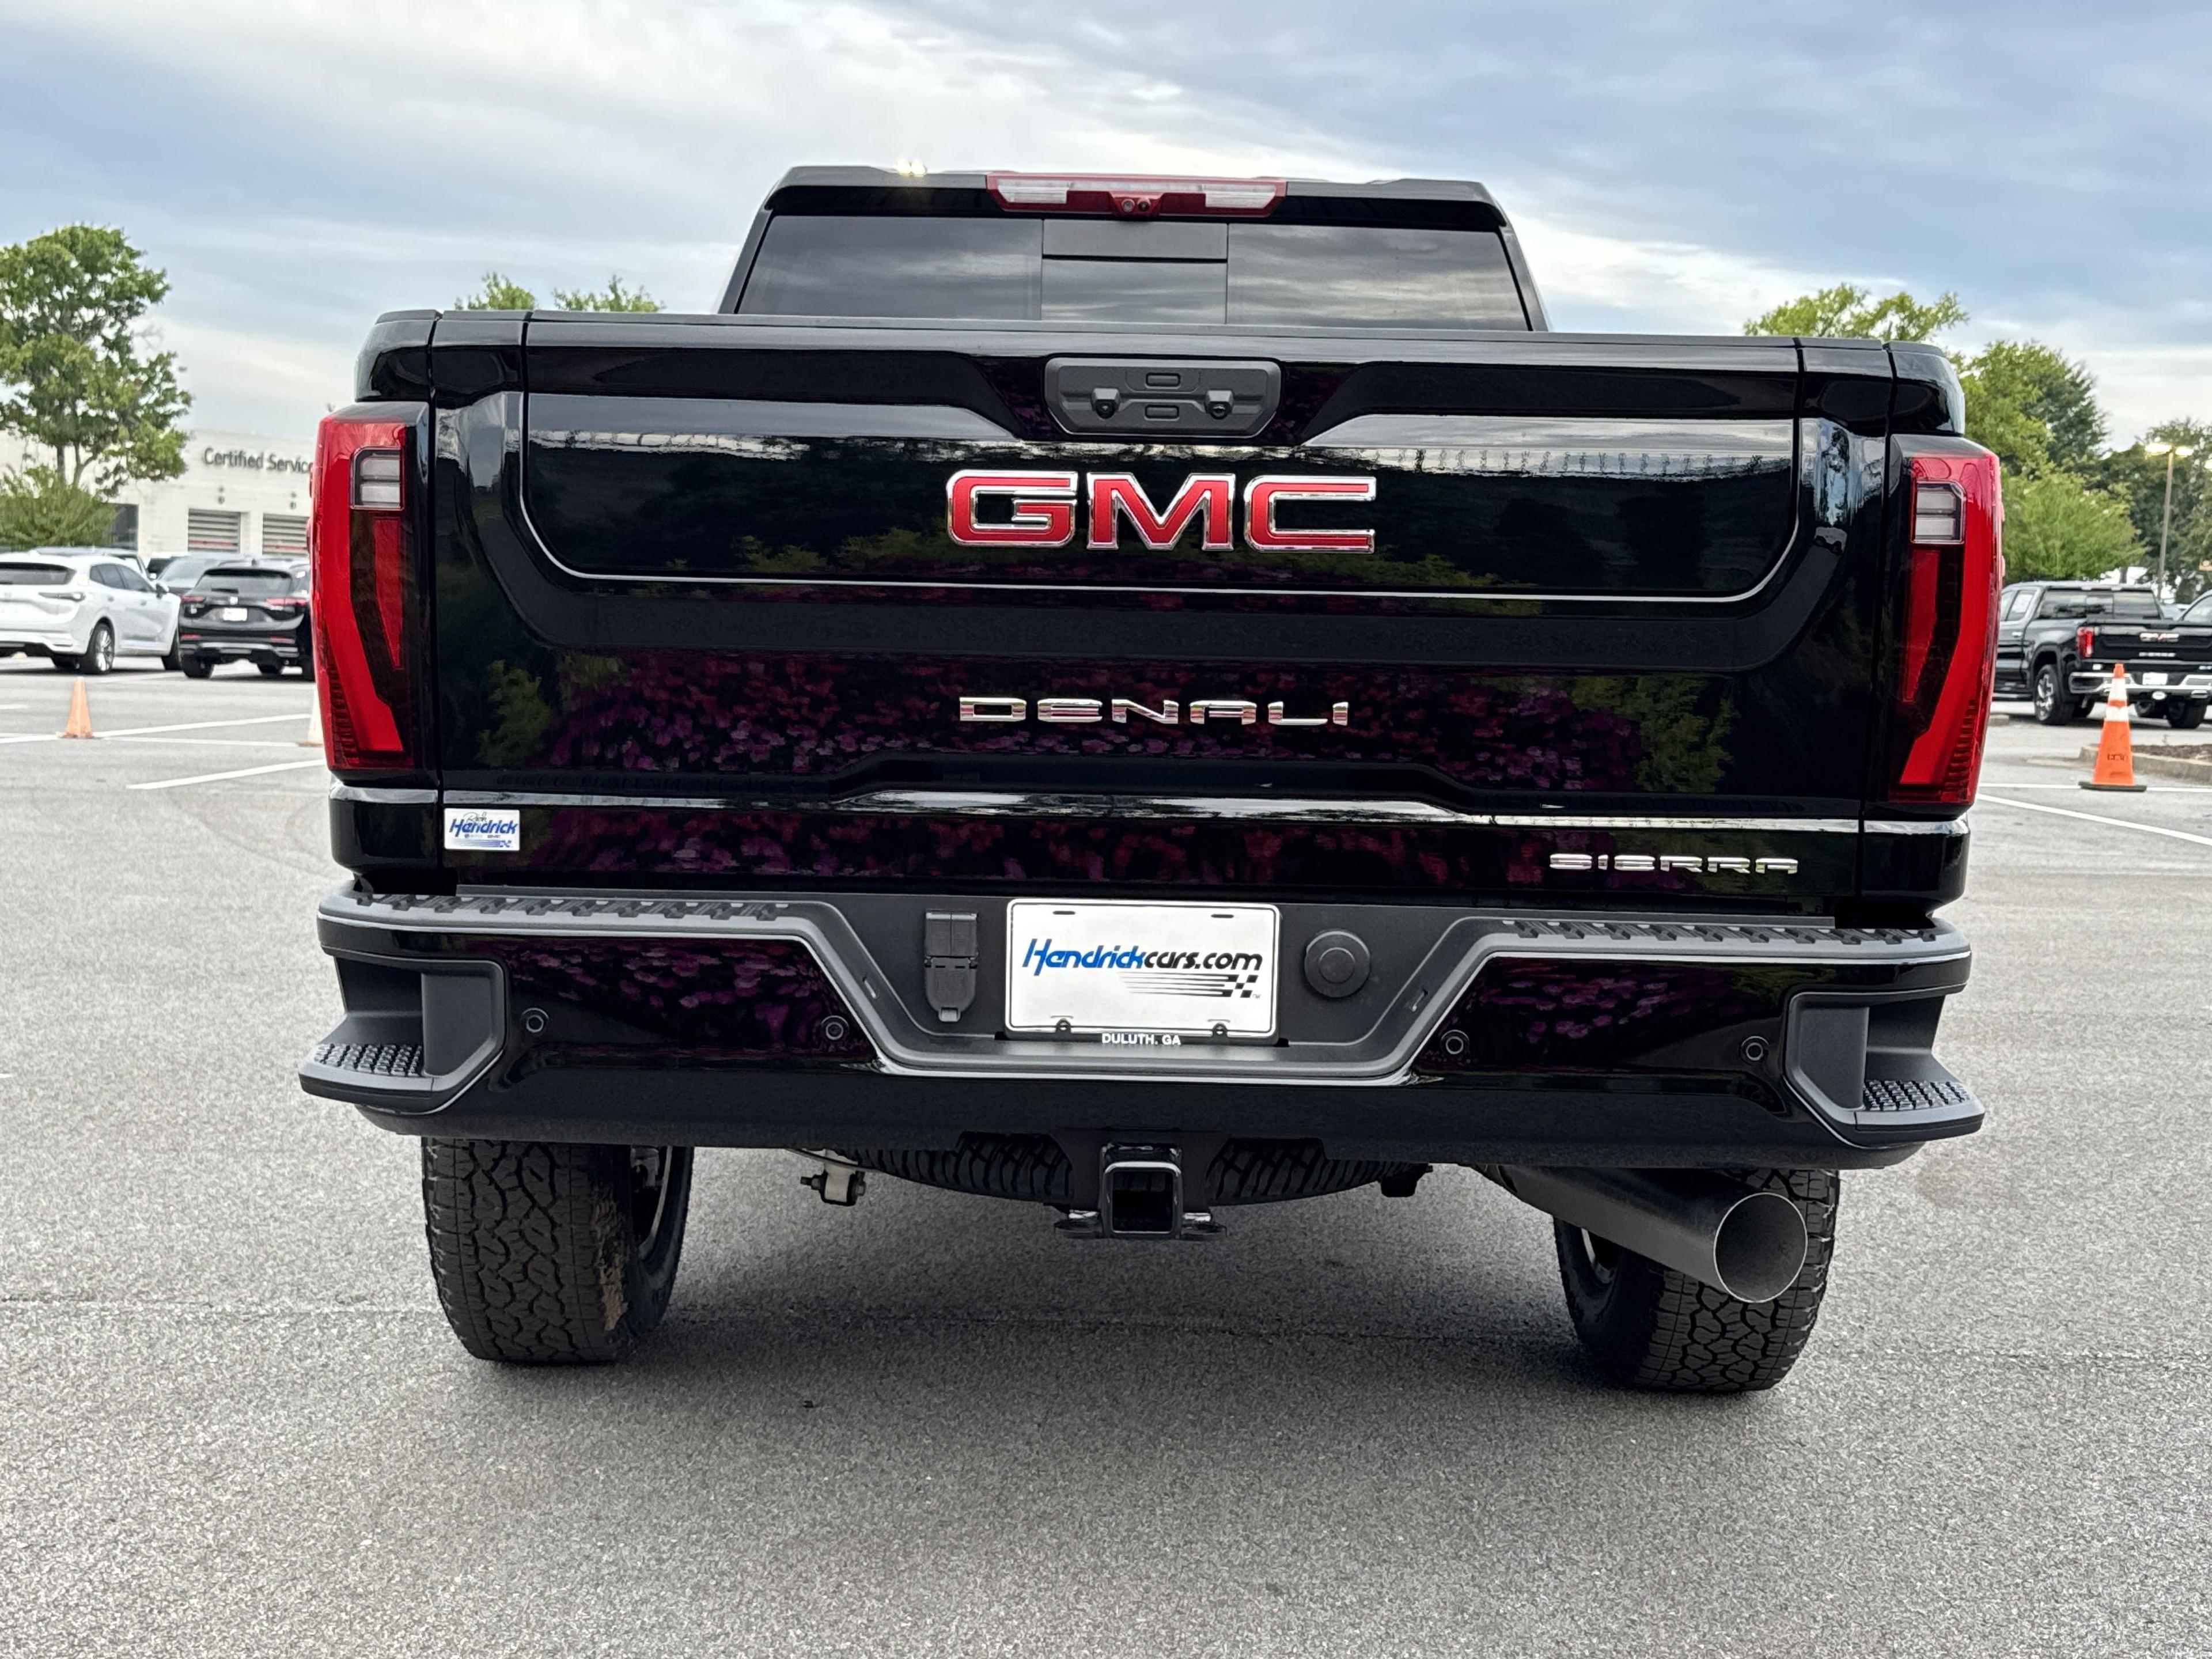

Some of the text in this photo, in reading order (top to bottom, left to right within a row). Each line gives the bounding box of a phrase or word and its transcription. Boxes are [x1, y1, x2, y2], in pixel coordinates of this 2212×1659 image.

[204, 447, 264, 469] Certified
[946, 469, 1377, 554] GMC
[959, 697, 1349, 726] DENALI
[449, 818, 518, 838] Hendrick
[1550, 853, 1798, 874] SIERRA
[1022, 938, 1263, 976] Hendrickcars.com
[1161, 1034, 1181, 1046] GA
